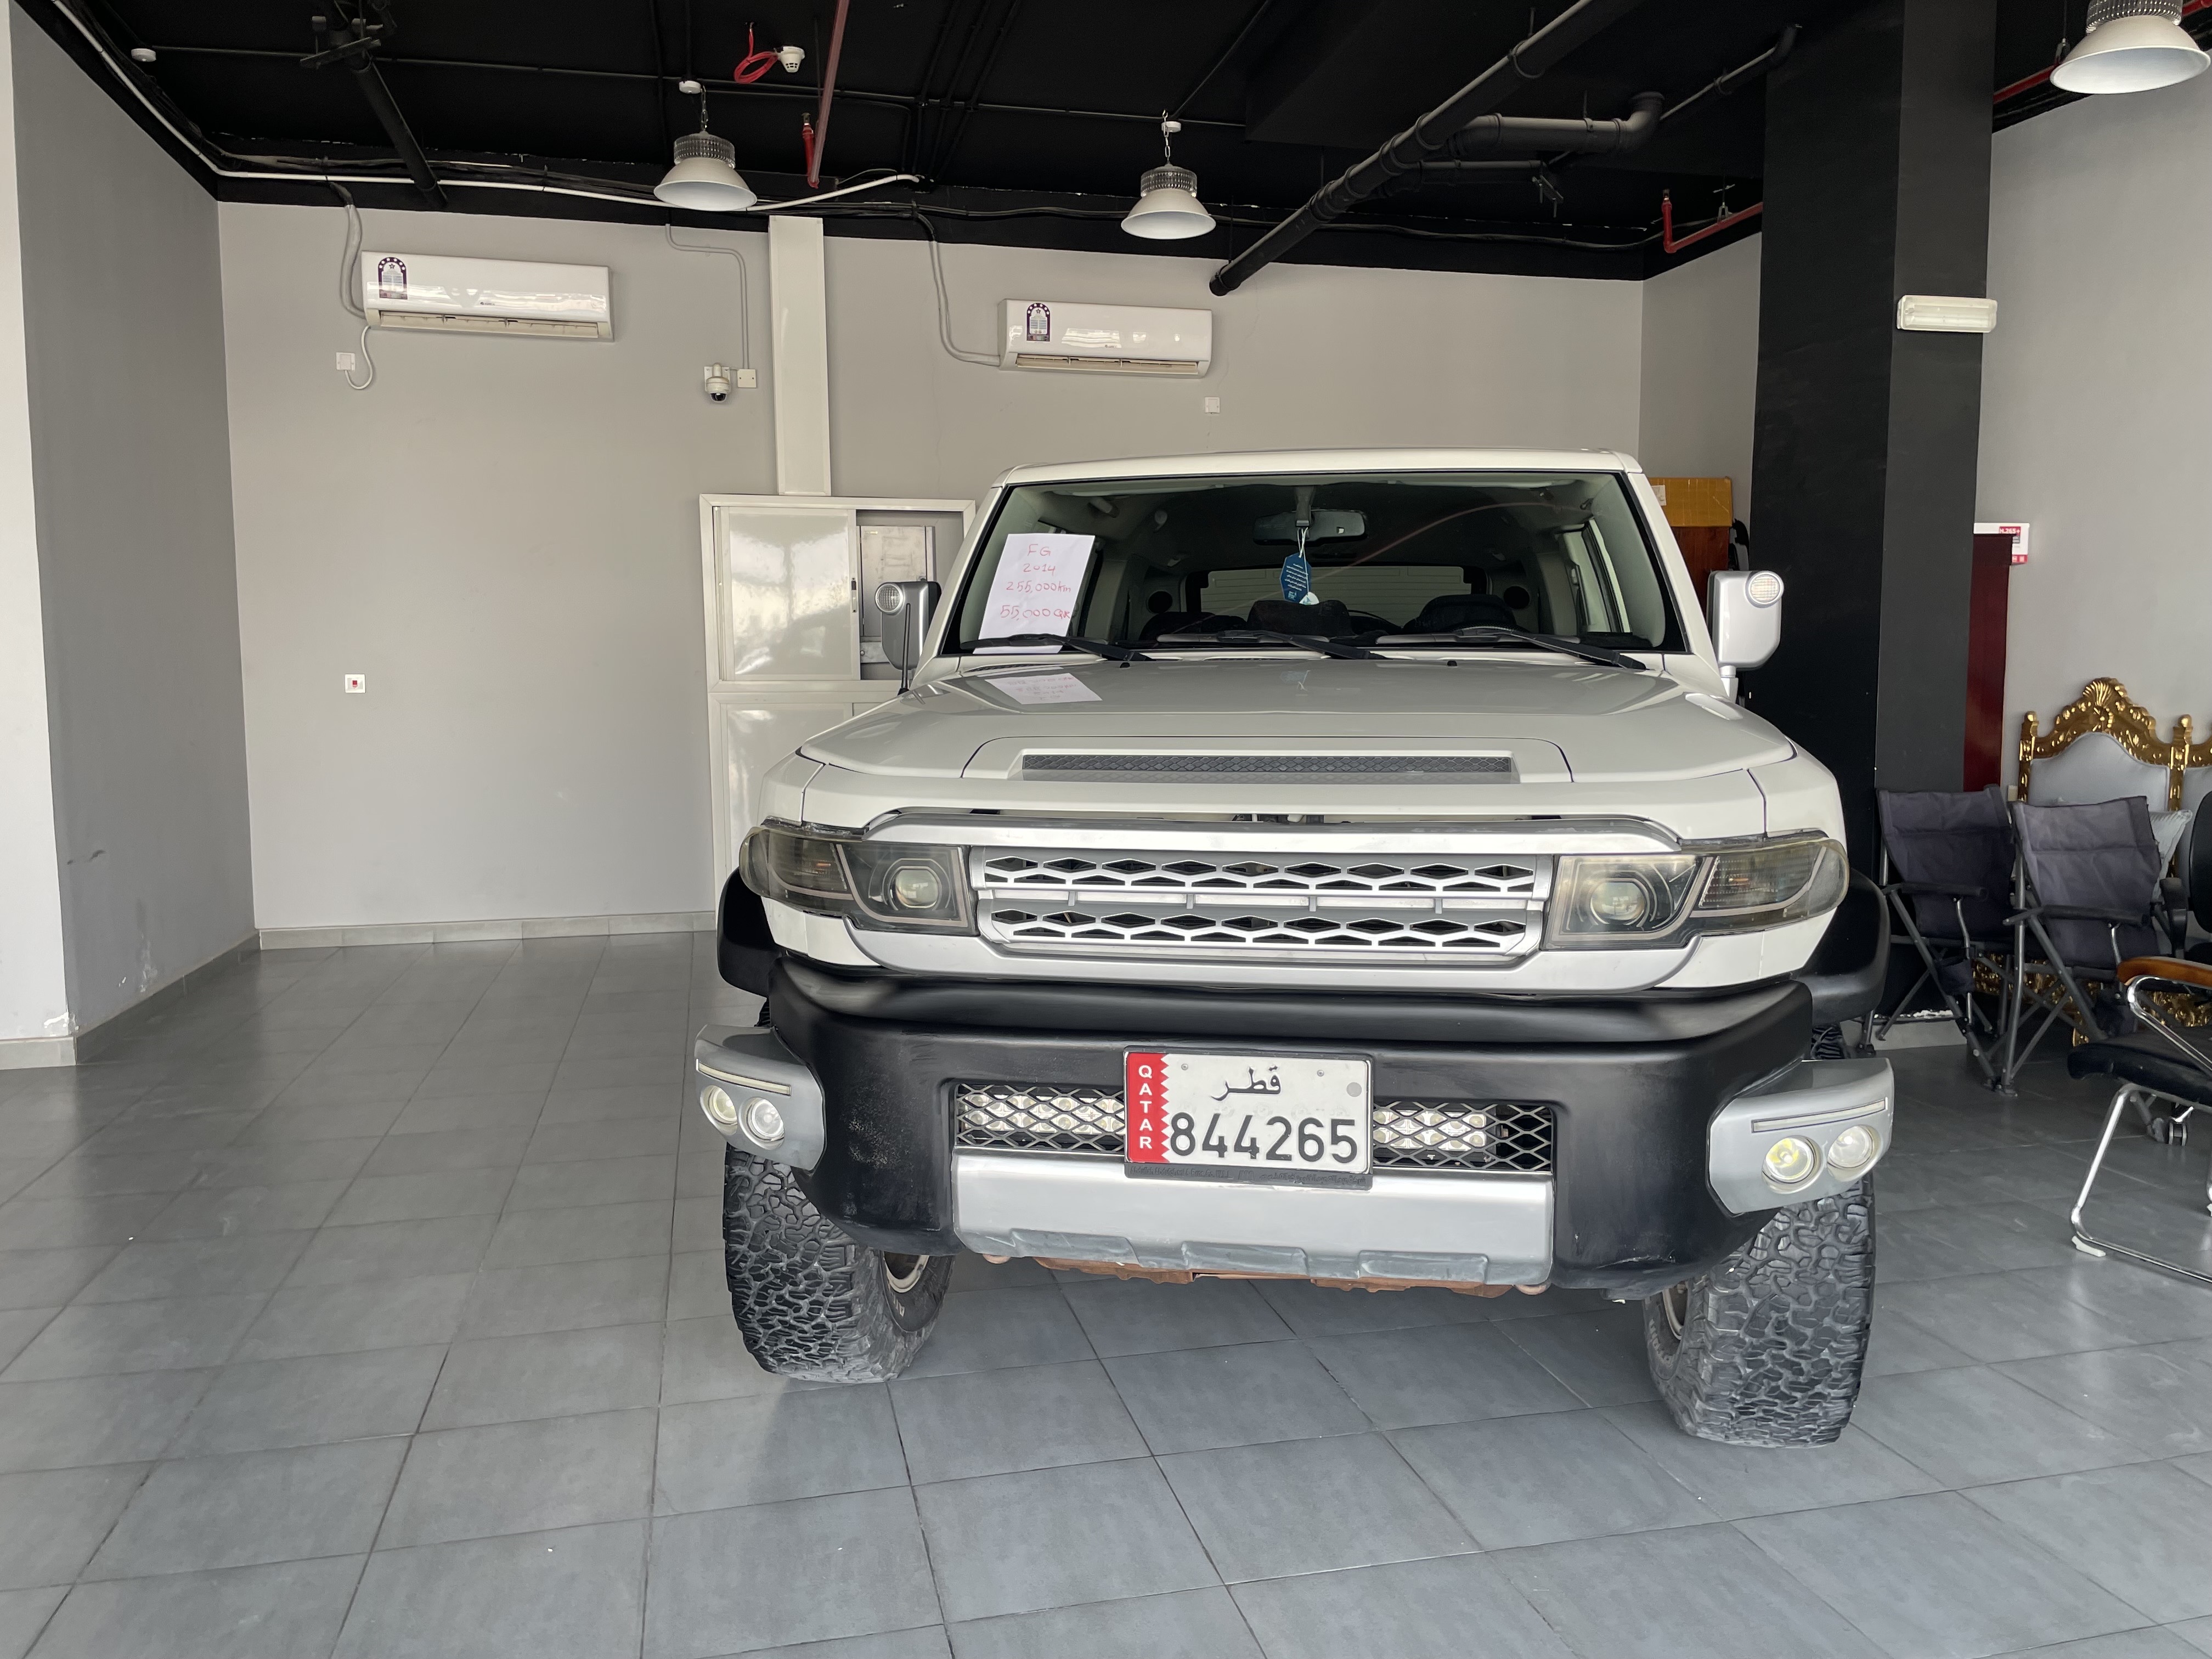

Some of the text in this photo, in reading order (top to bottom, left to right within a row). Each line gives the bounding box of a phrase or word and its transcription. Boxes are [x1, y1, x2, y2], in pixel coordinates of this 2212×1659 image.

[1023, 563, 1056, 577] 2014
[1210, 1065, 1282, 1101] قطر
[1138, 1064, 1153, 1149] QATAR
[1170, 1111, 1358, 1164] 844265
